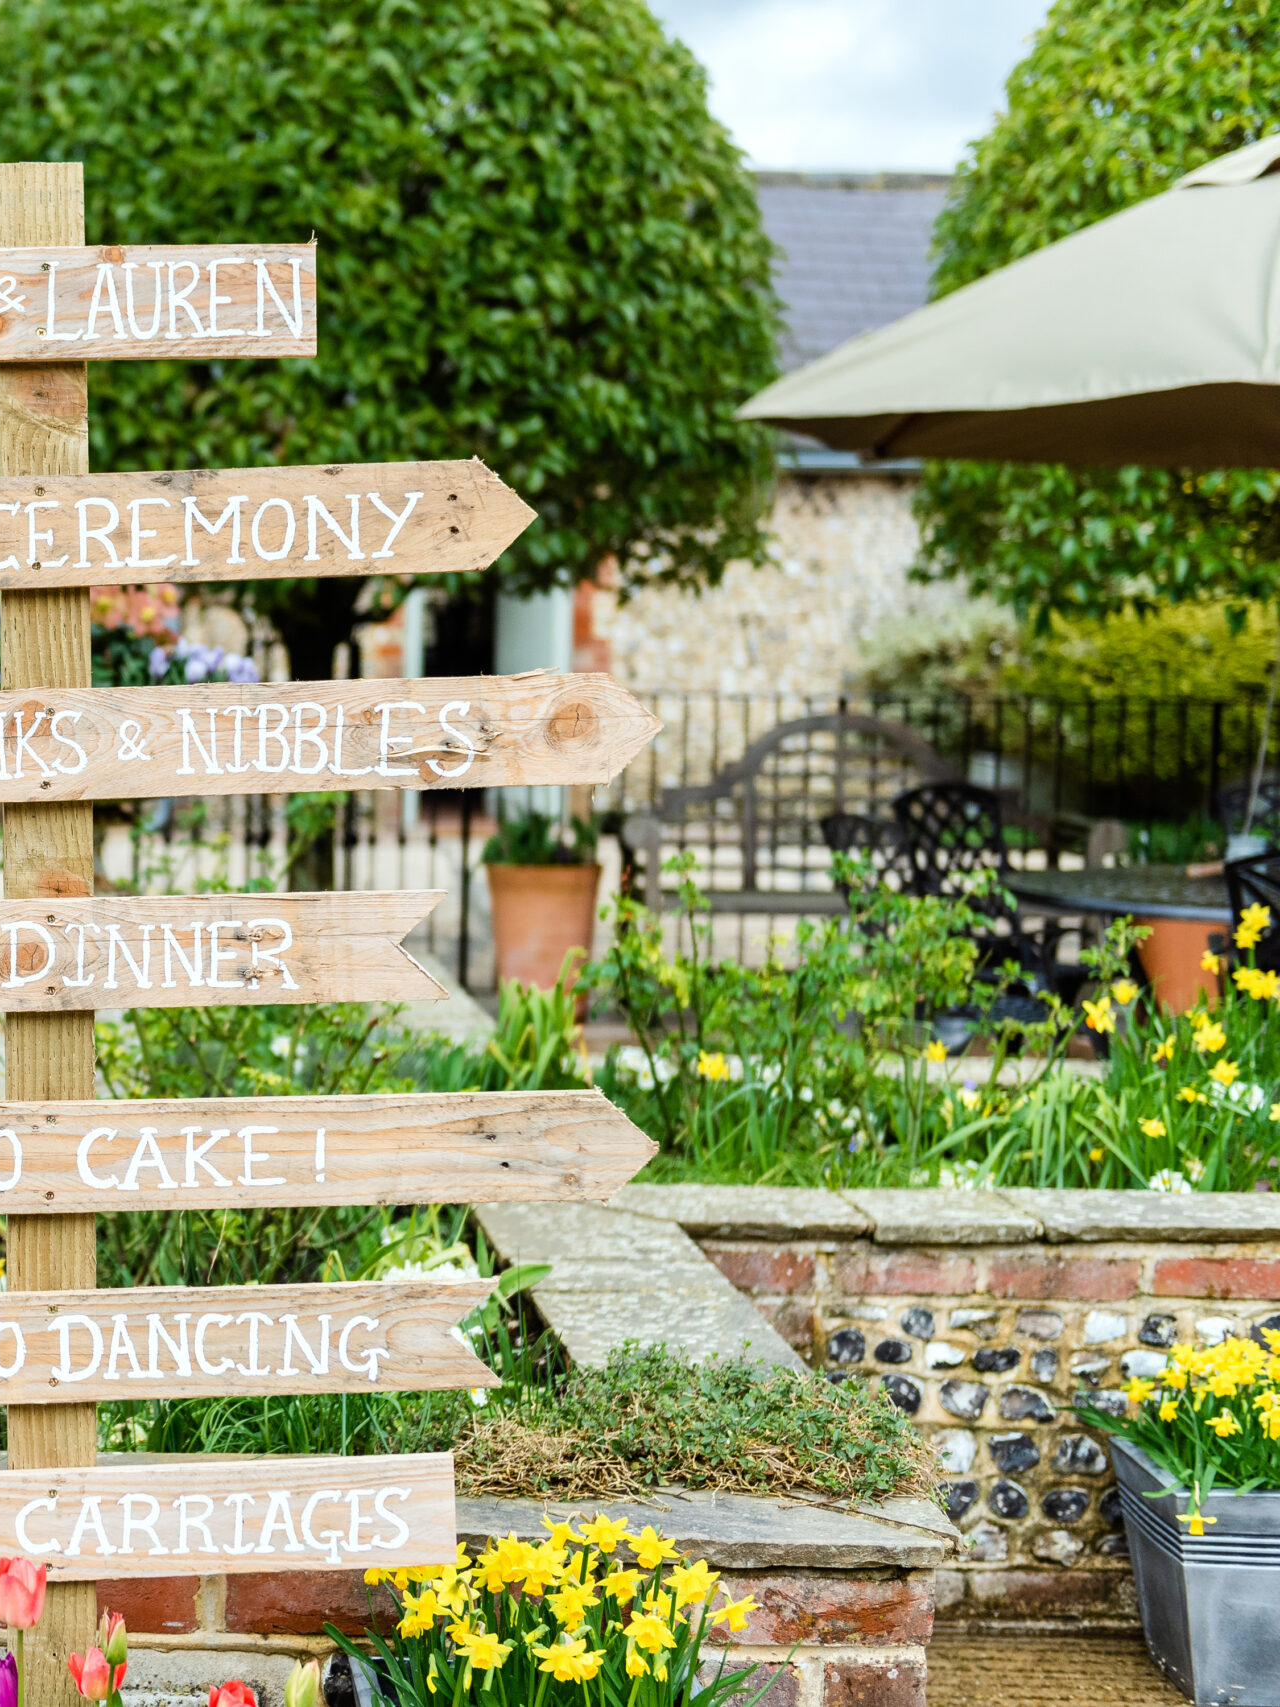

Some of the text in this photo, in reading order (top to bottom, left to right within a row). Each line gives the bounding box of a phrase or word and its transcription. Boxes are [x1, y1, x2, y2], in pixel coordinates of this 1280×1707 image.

[40, 257, 304, 342] LAUREN
[119, 718, 153, 761] &
[176, 699, 478, 779] NIBBLES
[1, 917, 301, 990] DINNER
[50, 1311, 391, 1383] DANCING
[15, 1486, 413, 1564] CARRIAGES
